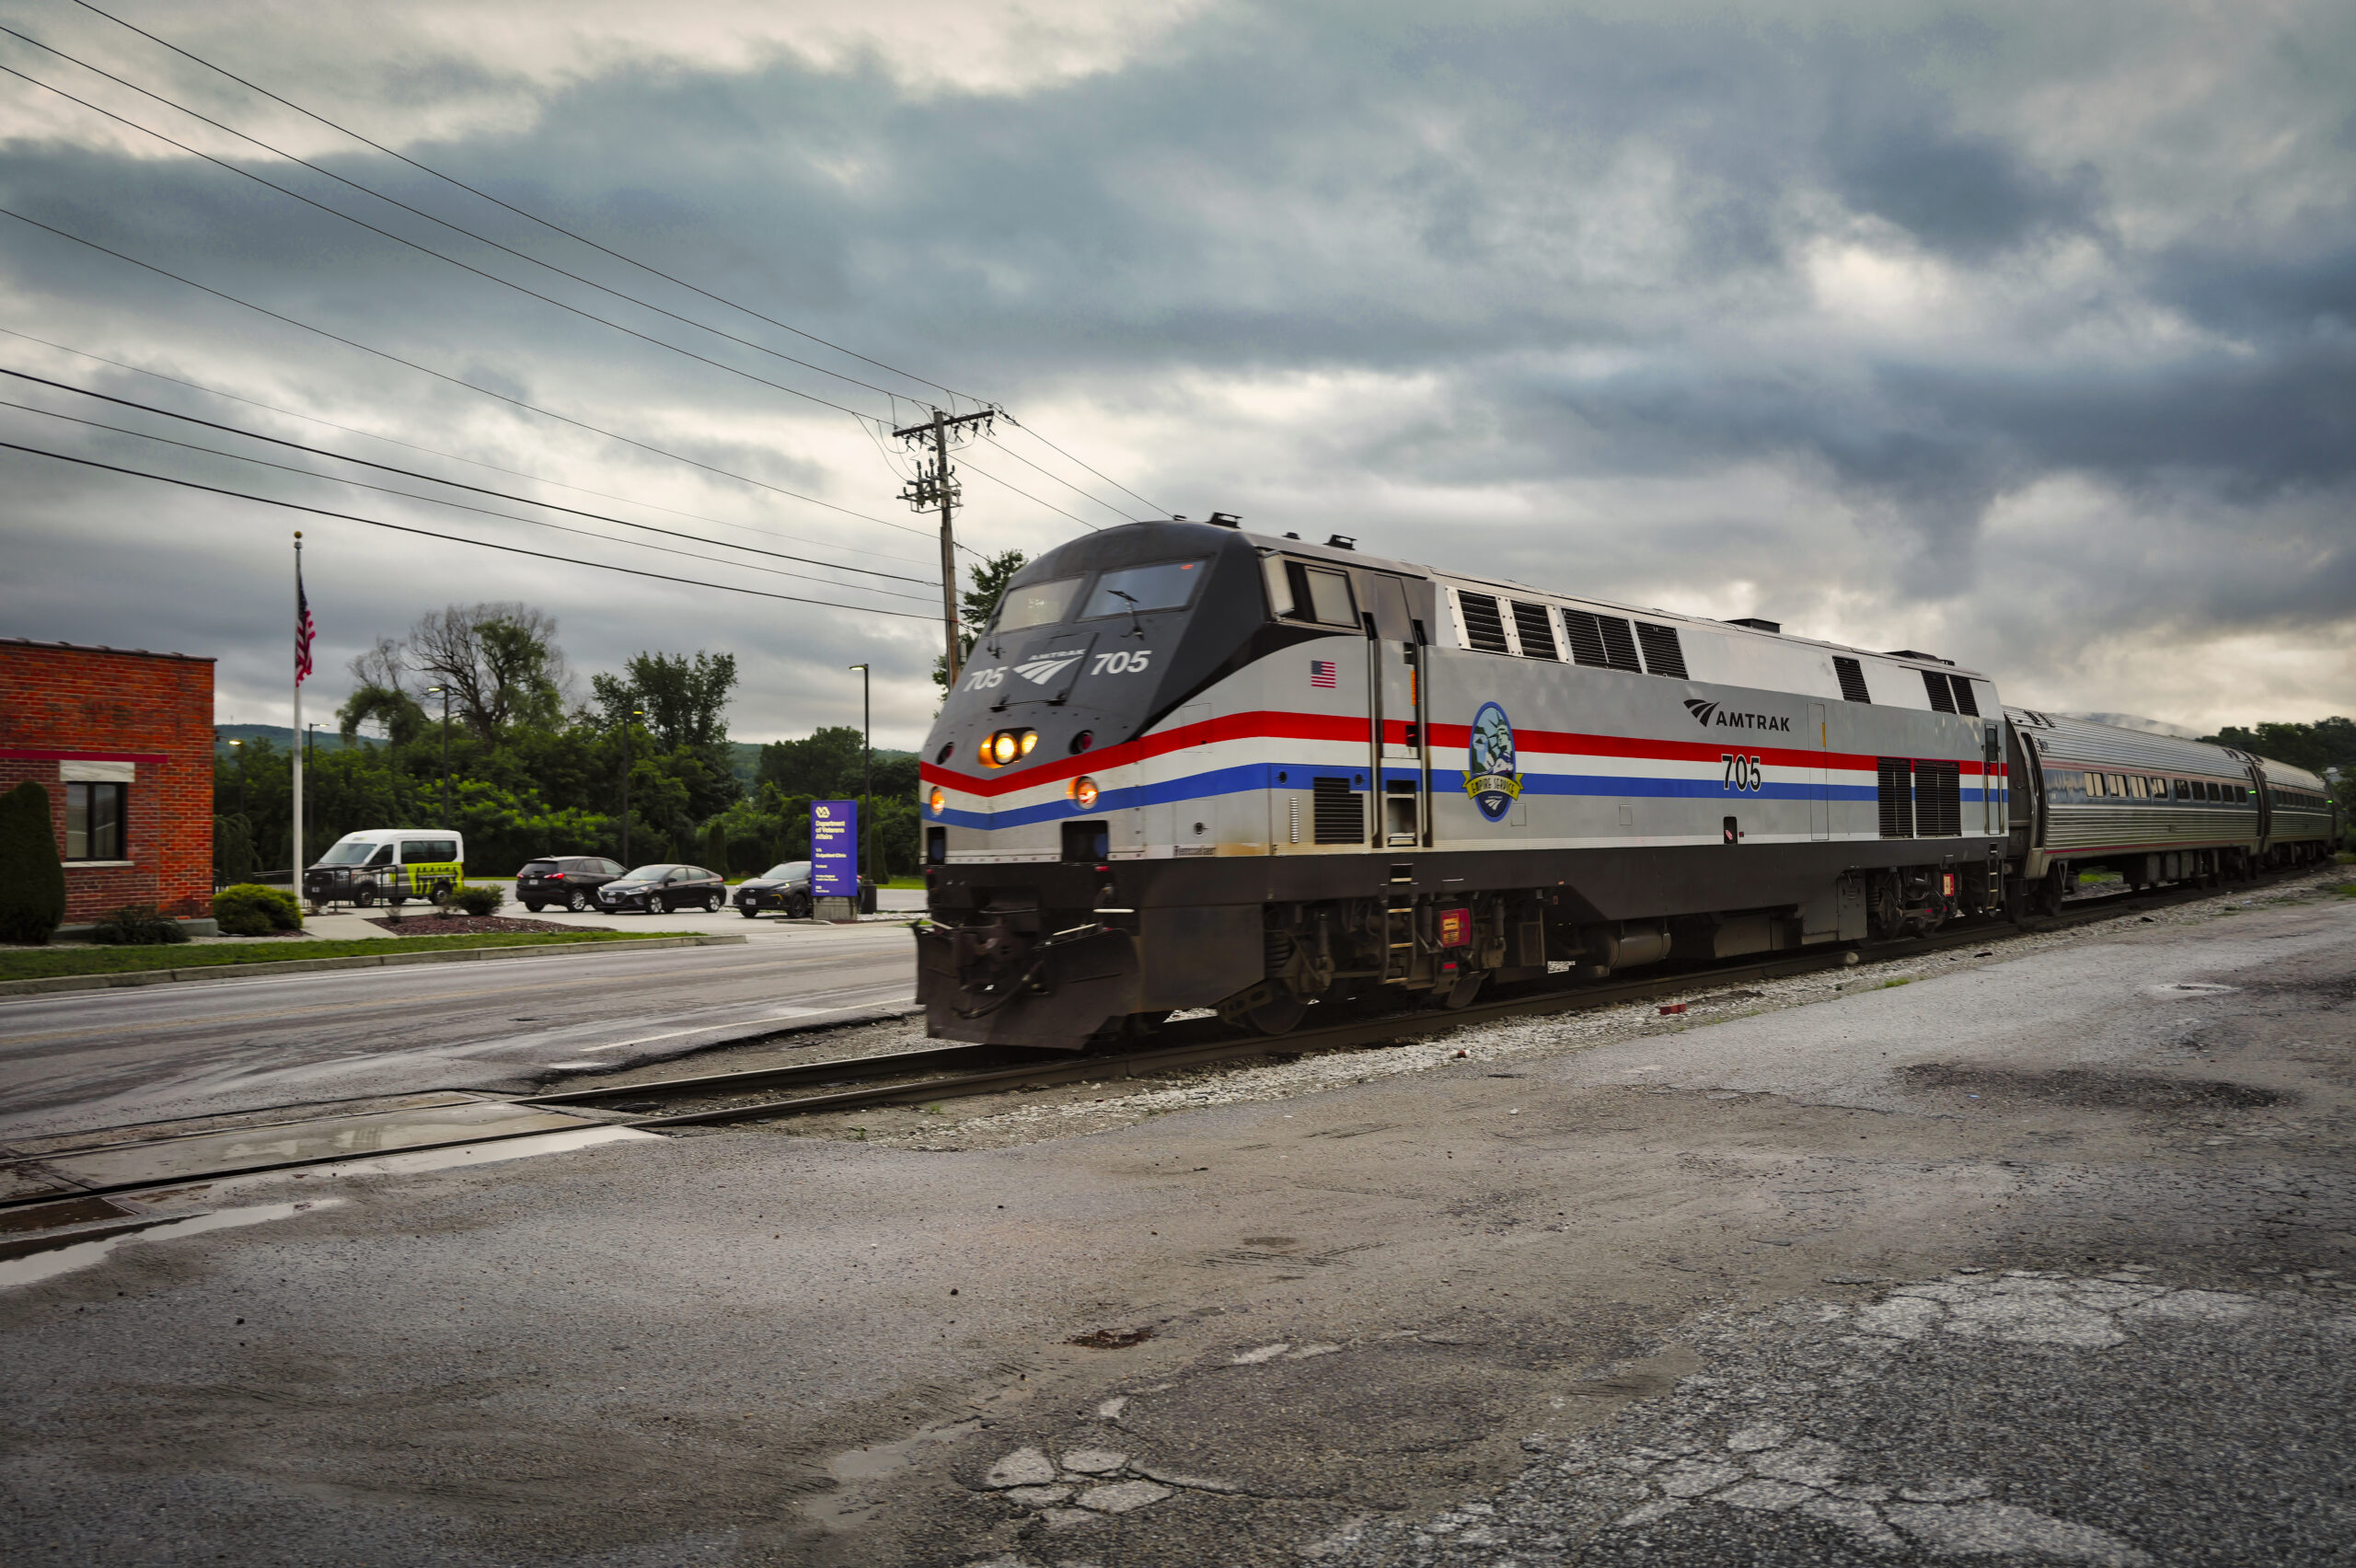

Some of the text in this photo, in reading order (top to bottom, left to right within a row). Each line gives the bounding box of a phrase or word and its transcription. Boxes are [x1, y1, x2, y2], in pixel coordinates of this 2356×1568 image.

[1028, 649, 1086, 661] AMTRAK
[1091, 650, 1152, 675] 705
[964, 665, 1009, 692] 705
[1715, 710, 1790, 732] AMTRAK
[1721, 753, 1761, 791] 705
[1472, 778, 1515, 794] EMPIRE SERVICE
[815, 820, 846, 828] Department
